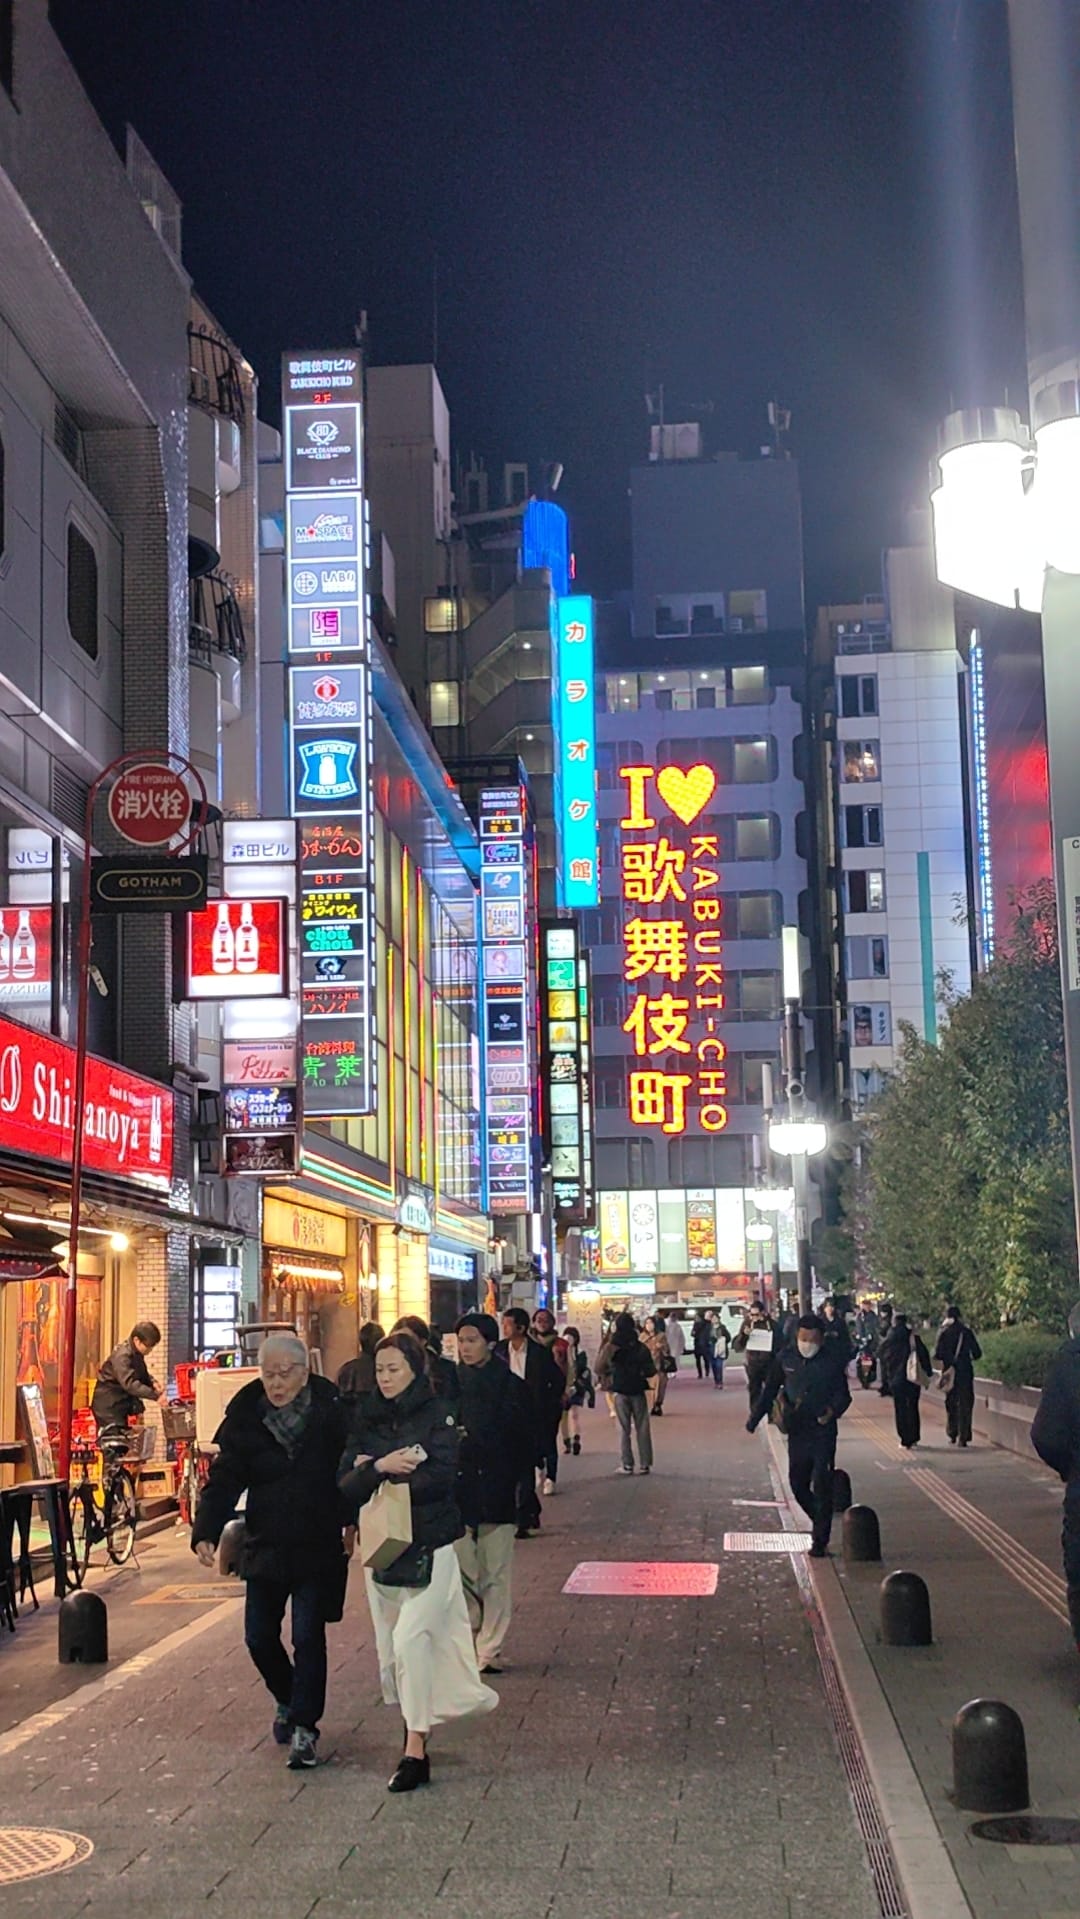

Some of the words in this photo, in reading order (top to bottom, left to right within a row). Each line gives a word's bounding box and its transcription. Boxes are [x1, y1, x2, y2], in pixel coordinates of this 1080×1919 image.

[314, 394, 331, 403] 2F
[322, 571, 354, 583] LABO
[316, 653, 332, 662] 1F
[305, 744, 351, 756] LAWSON
[566, 622, 592, 881] カラオケ館
[124, 775, 141, 784] FIRE
[143, 775, 177, 784] HYDRANT
[305, 783, 351, 794] STATION
[118, 789, 184, 819] 消火栓
[619, 767, 655, 830] I
[231, 843, 289, 858] 森田ビル
[119, 877, 182, 888] GOTHAM
[315, 875, 344, 884] B1F
[305, 928, 349, 940] chou
[310, 939, 353, 951] chou
[623, 838, 692, 1133] 歌舞伎町
[691, 835, 727, 1131] KABUKI-CHO
[306, 1041, 355, 1055] 台湾料理
[303, 1055, 363, 1078] 青葉
[33, 1062, 139, 1163] Shianoya
